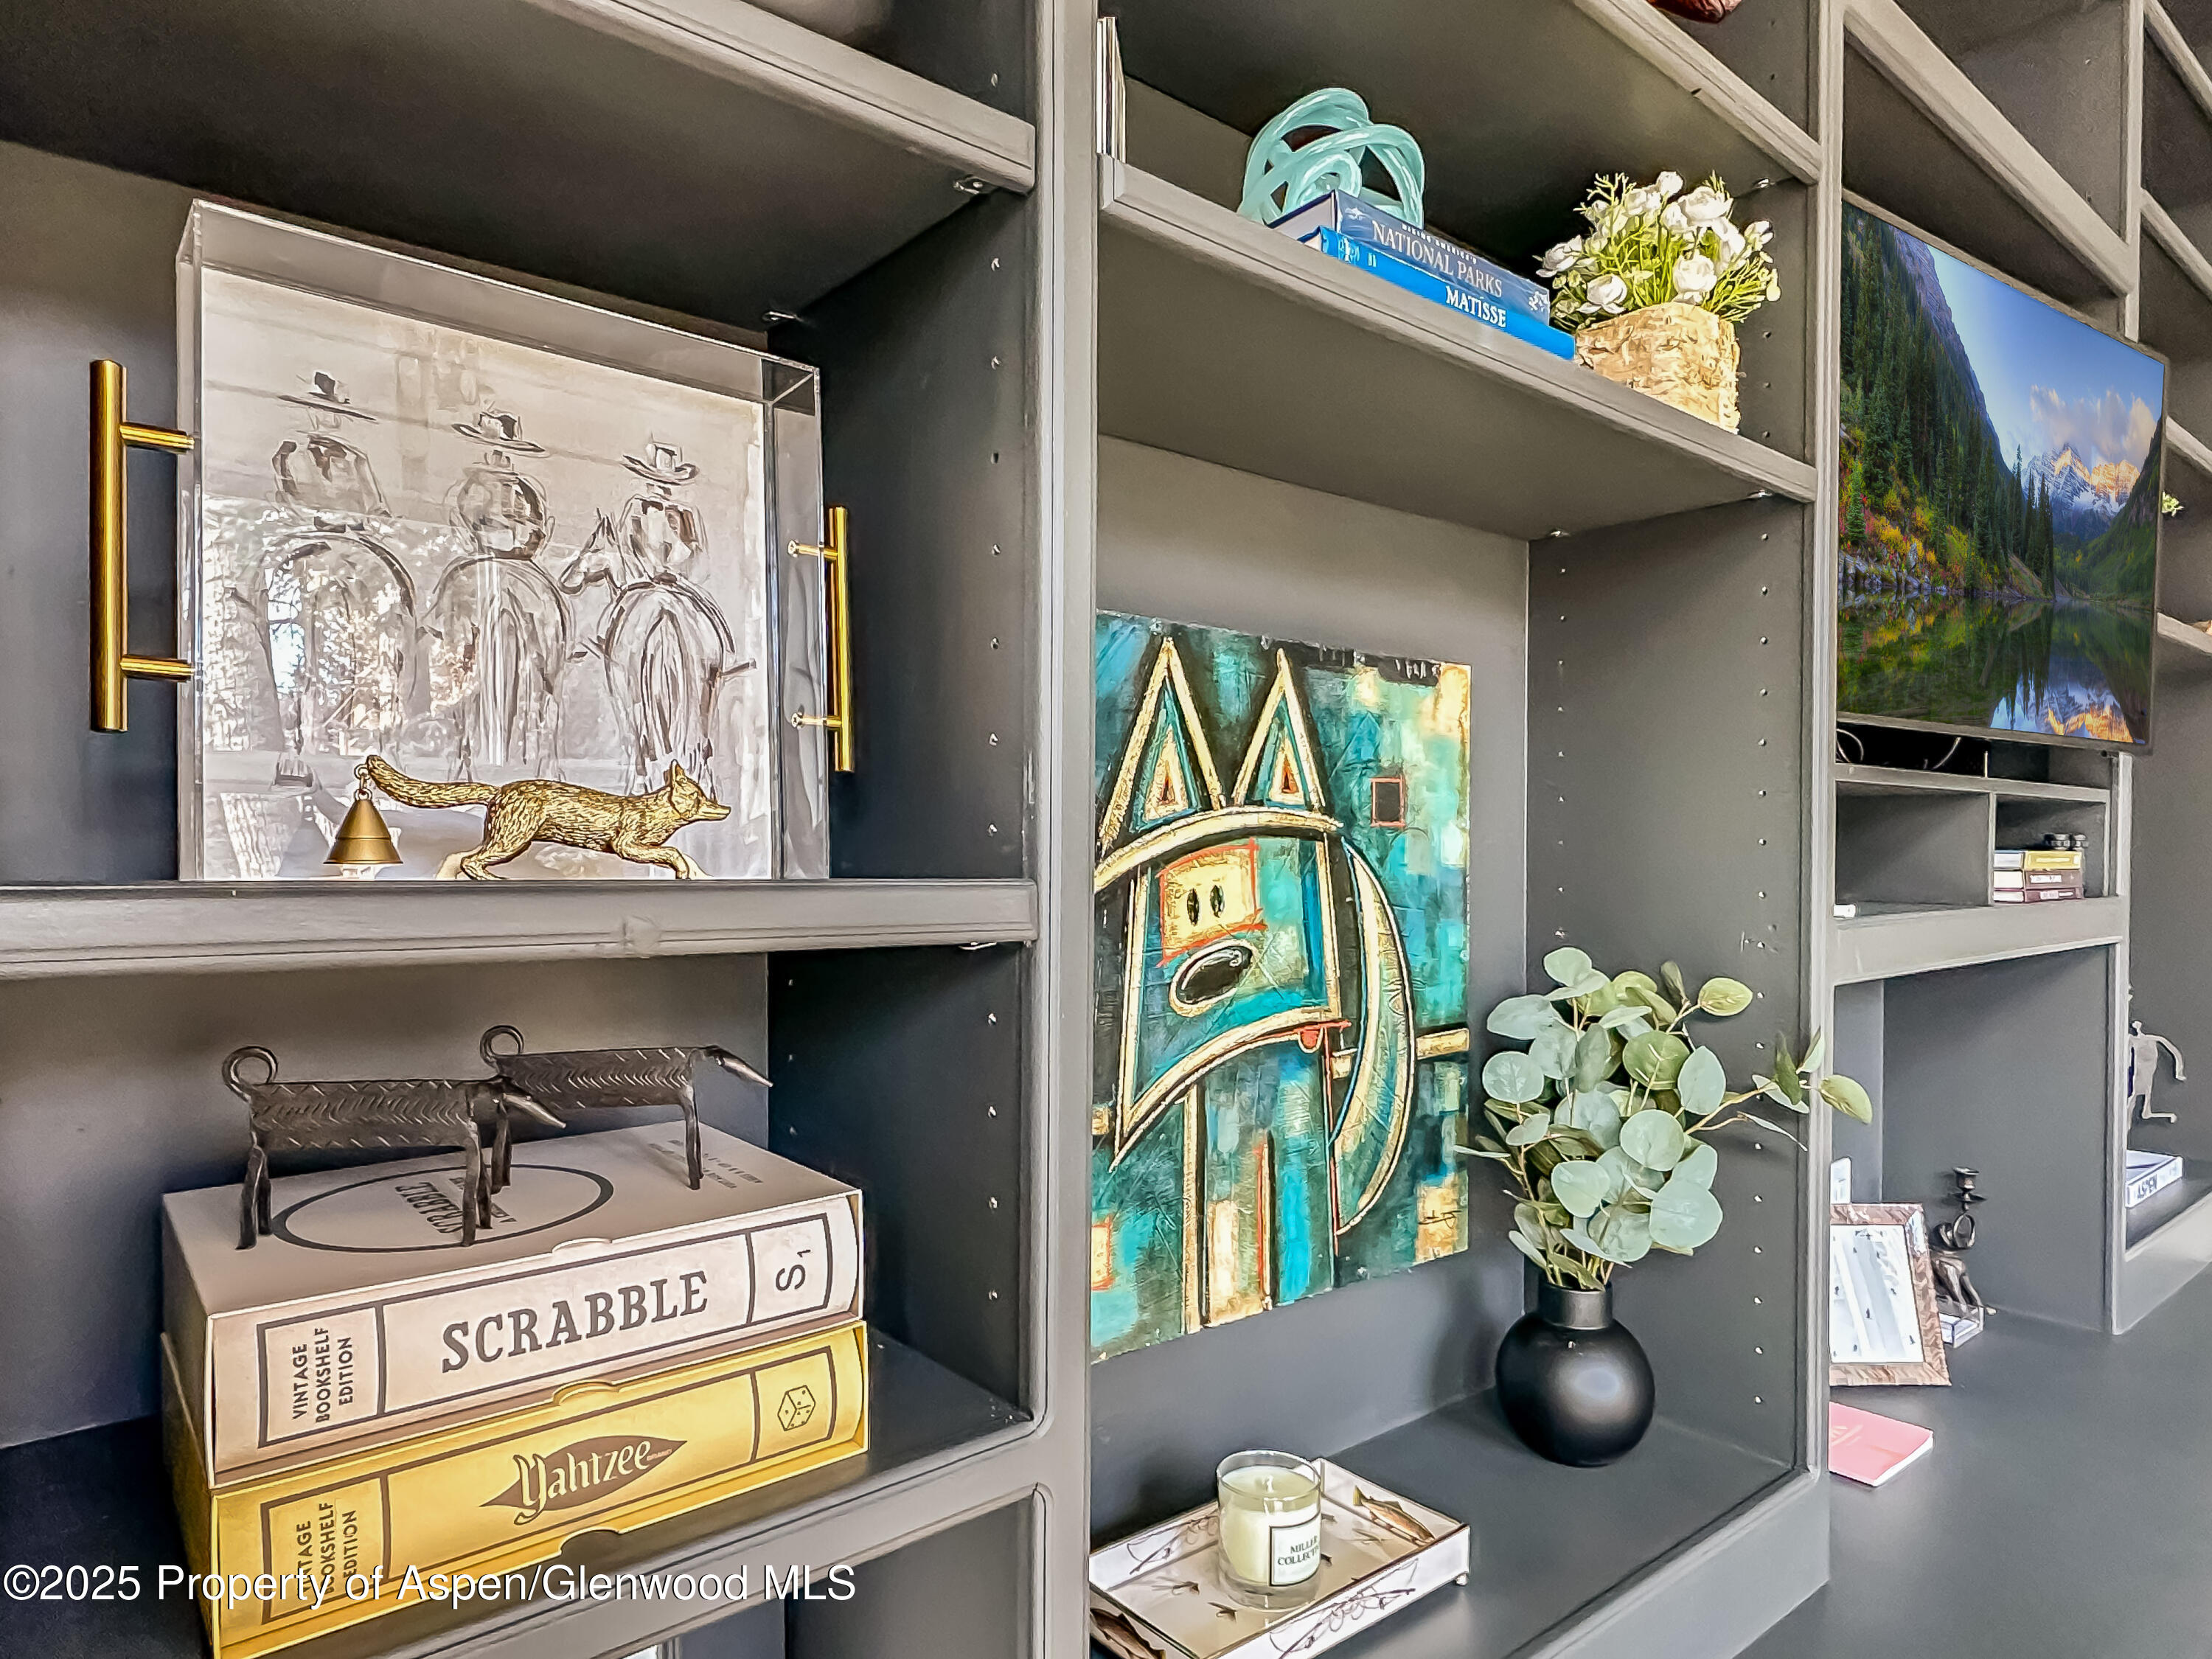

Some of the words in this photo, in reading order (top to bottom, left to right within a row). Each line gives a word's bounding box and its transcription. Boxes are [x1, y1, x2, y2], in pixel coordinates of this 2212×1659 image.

[1372, 220, 1453, 276] NATIONAL
[1457, 260, 1503, 297] PARKS
[1445, 285, 1507, 328] MATISSE
[442, 1270, 708, 1373] SCRABBLE
[292, 1343, 308, 1420] VINTAGE
[313, 1327, 331, 1423] BOOKSHELF
[337, 1337, 354, 1406] EDITION
[512, 1440, 652, 1526] Yahtzee
[341, 1509, 358, 1578] EDITION
